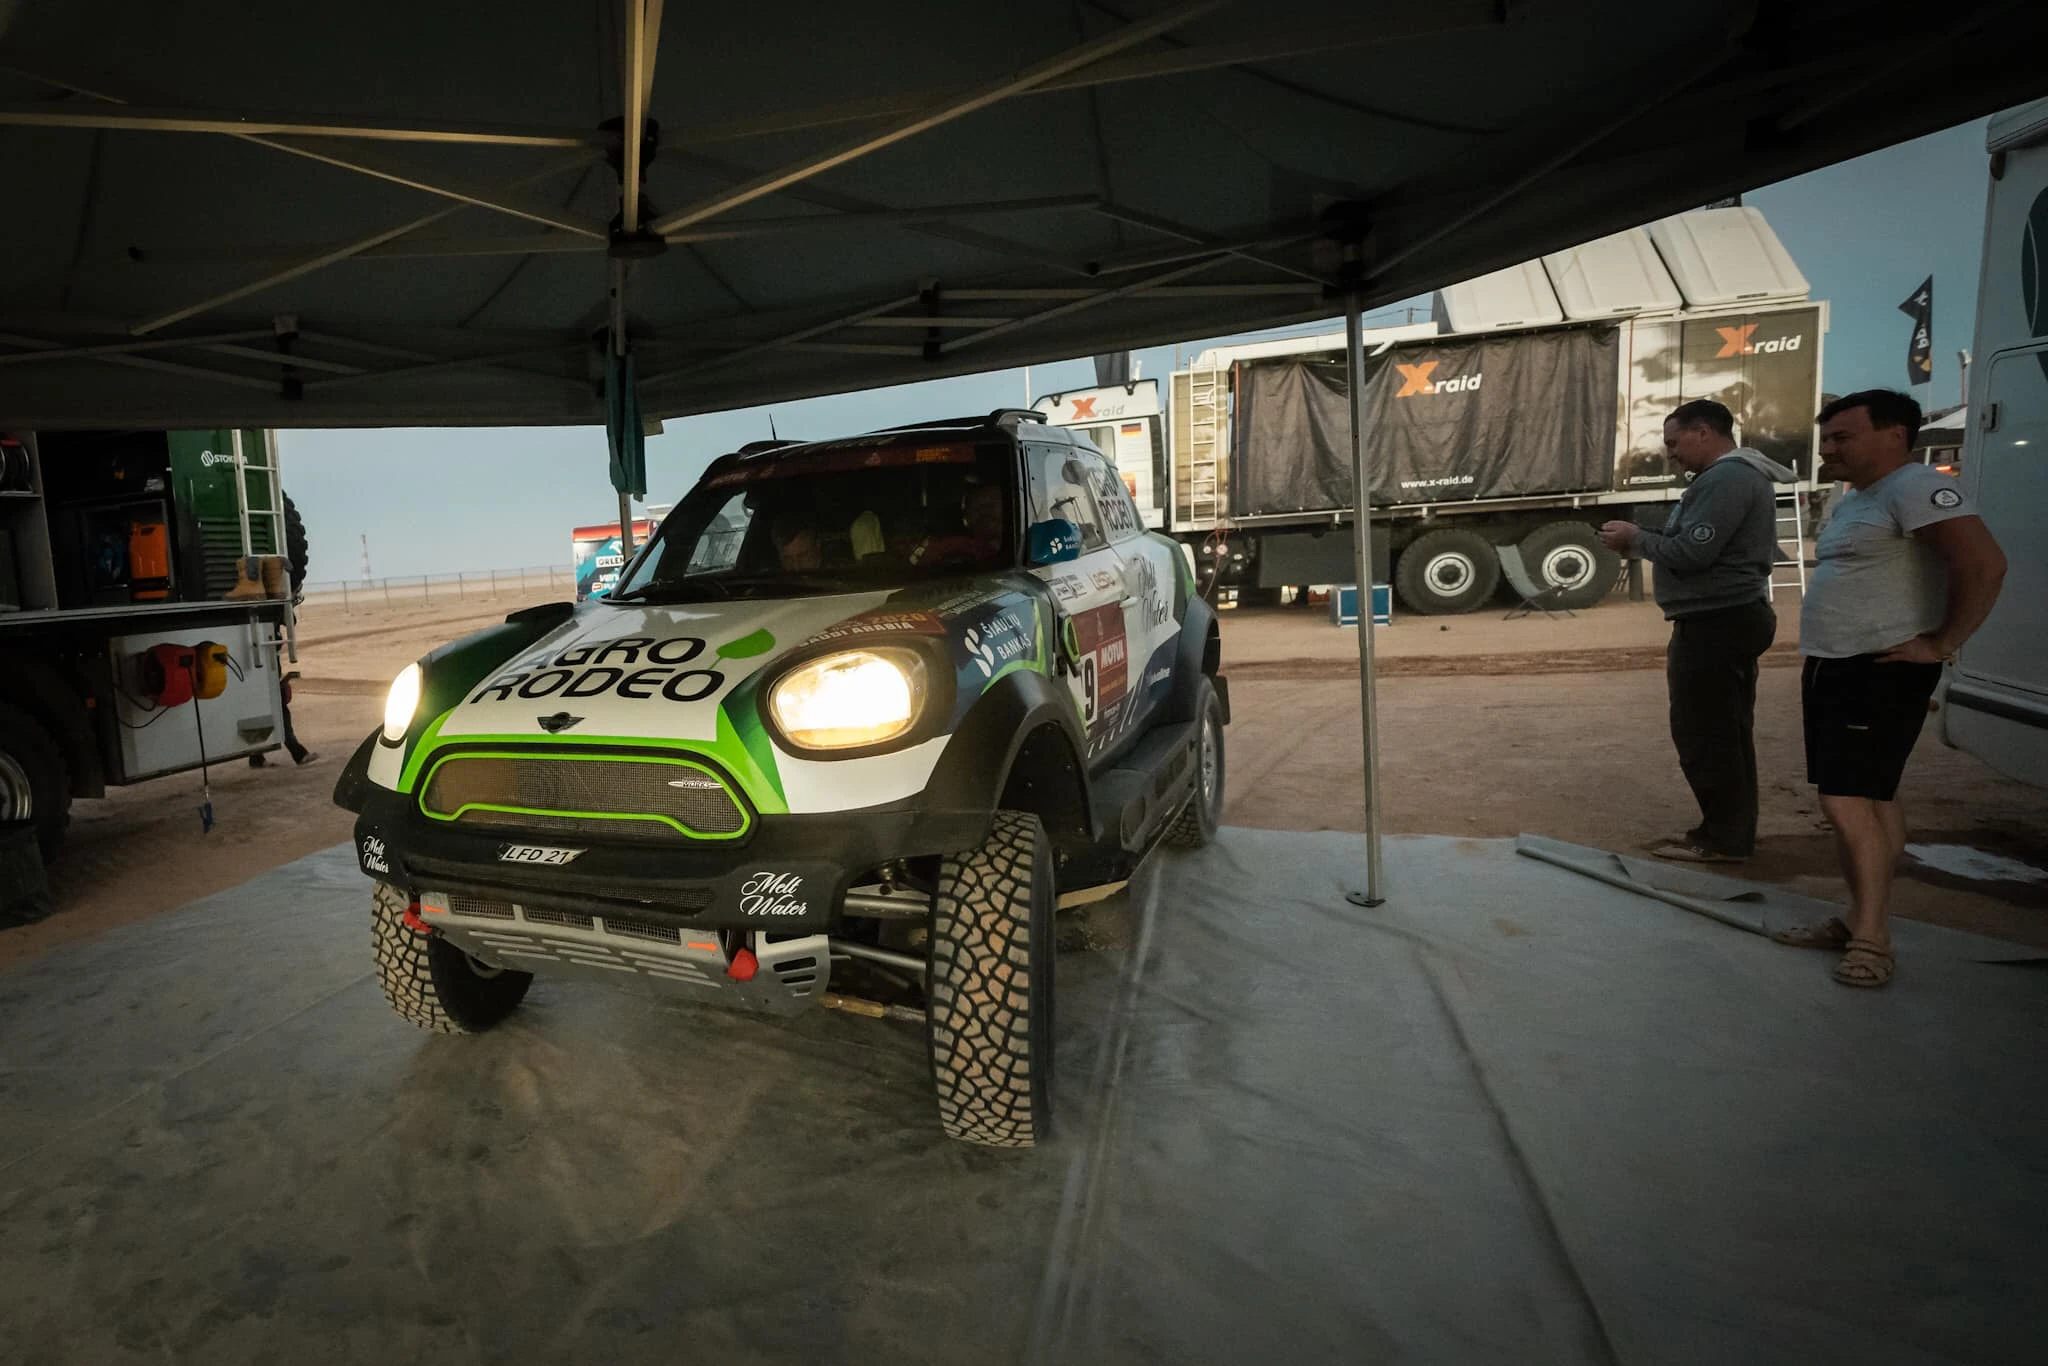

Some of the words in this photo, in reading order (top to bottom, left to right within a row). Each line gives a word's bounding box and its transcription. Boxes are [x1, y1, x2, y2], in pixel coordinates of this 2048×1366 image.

[214, 454, 249, 464] STOKR
[1400, 475, 1474, 489] www.x-raid.de
[851, 622, 915, 634] ARABIA
[997, 633, 1031, 660] BANKAS
[1101, 639, 1125, 670] MOTUL
[470, 667, 725, 703] RODEO
[506, 847, 543, 861] LFD
[741, 871, 803, 896] Melt
[739, 893, 808, 916] Water
